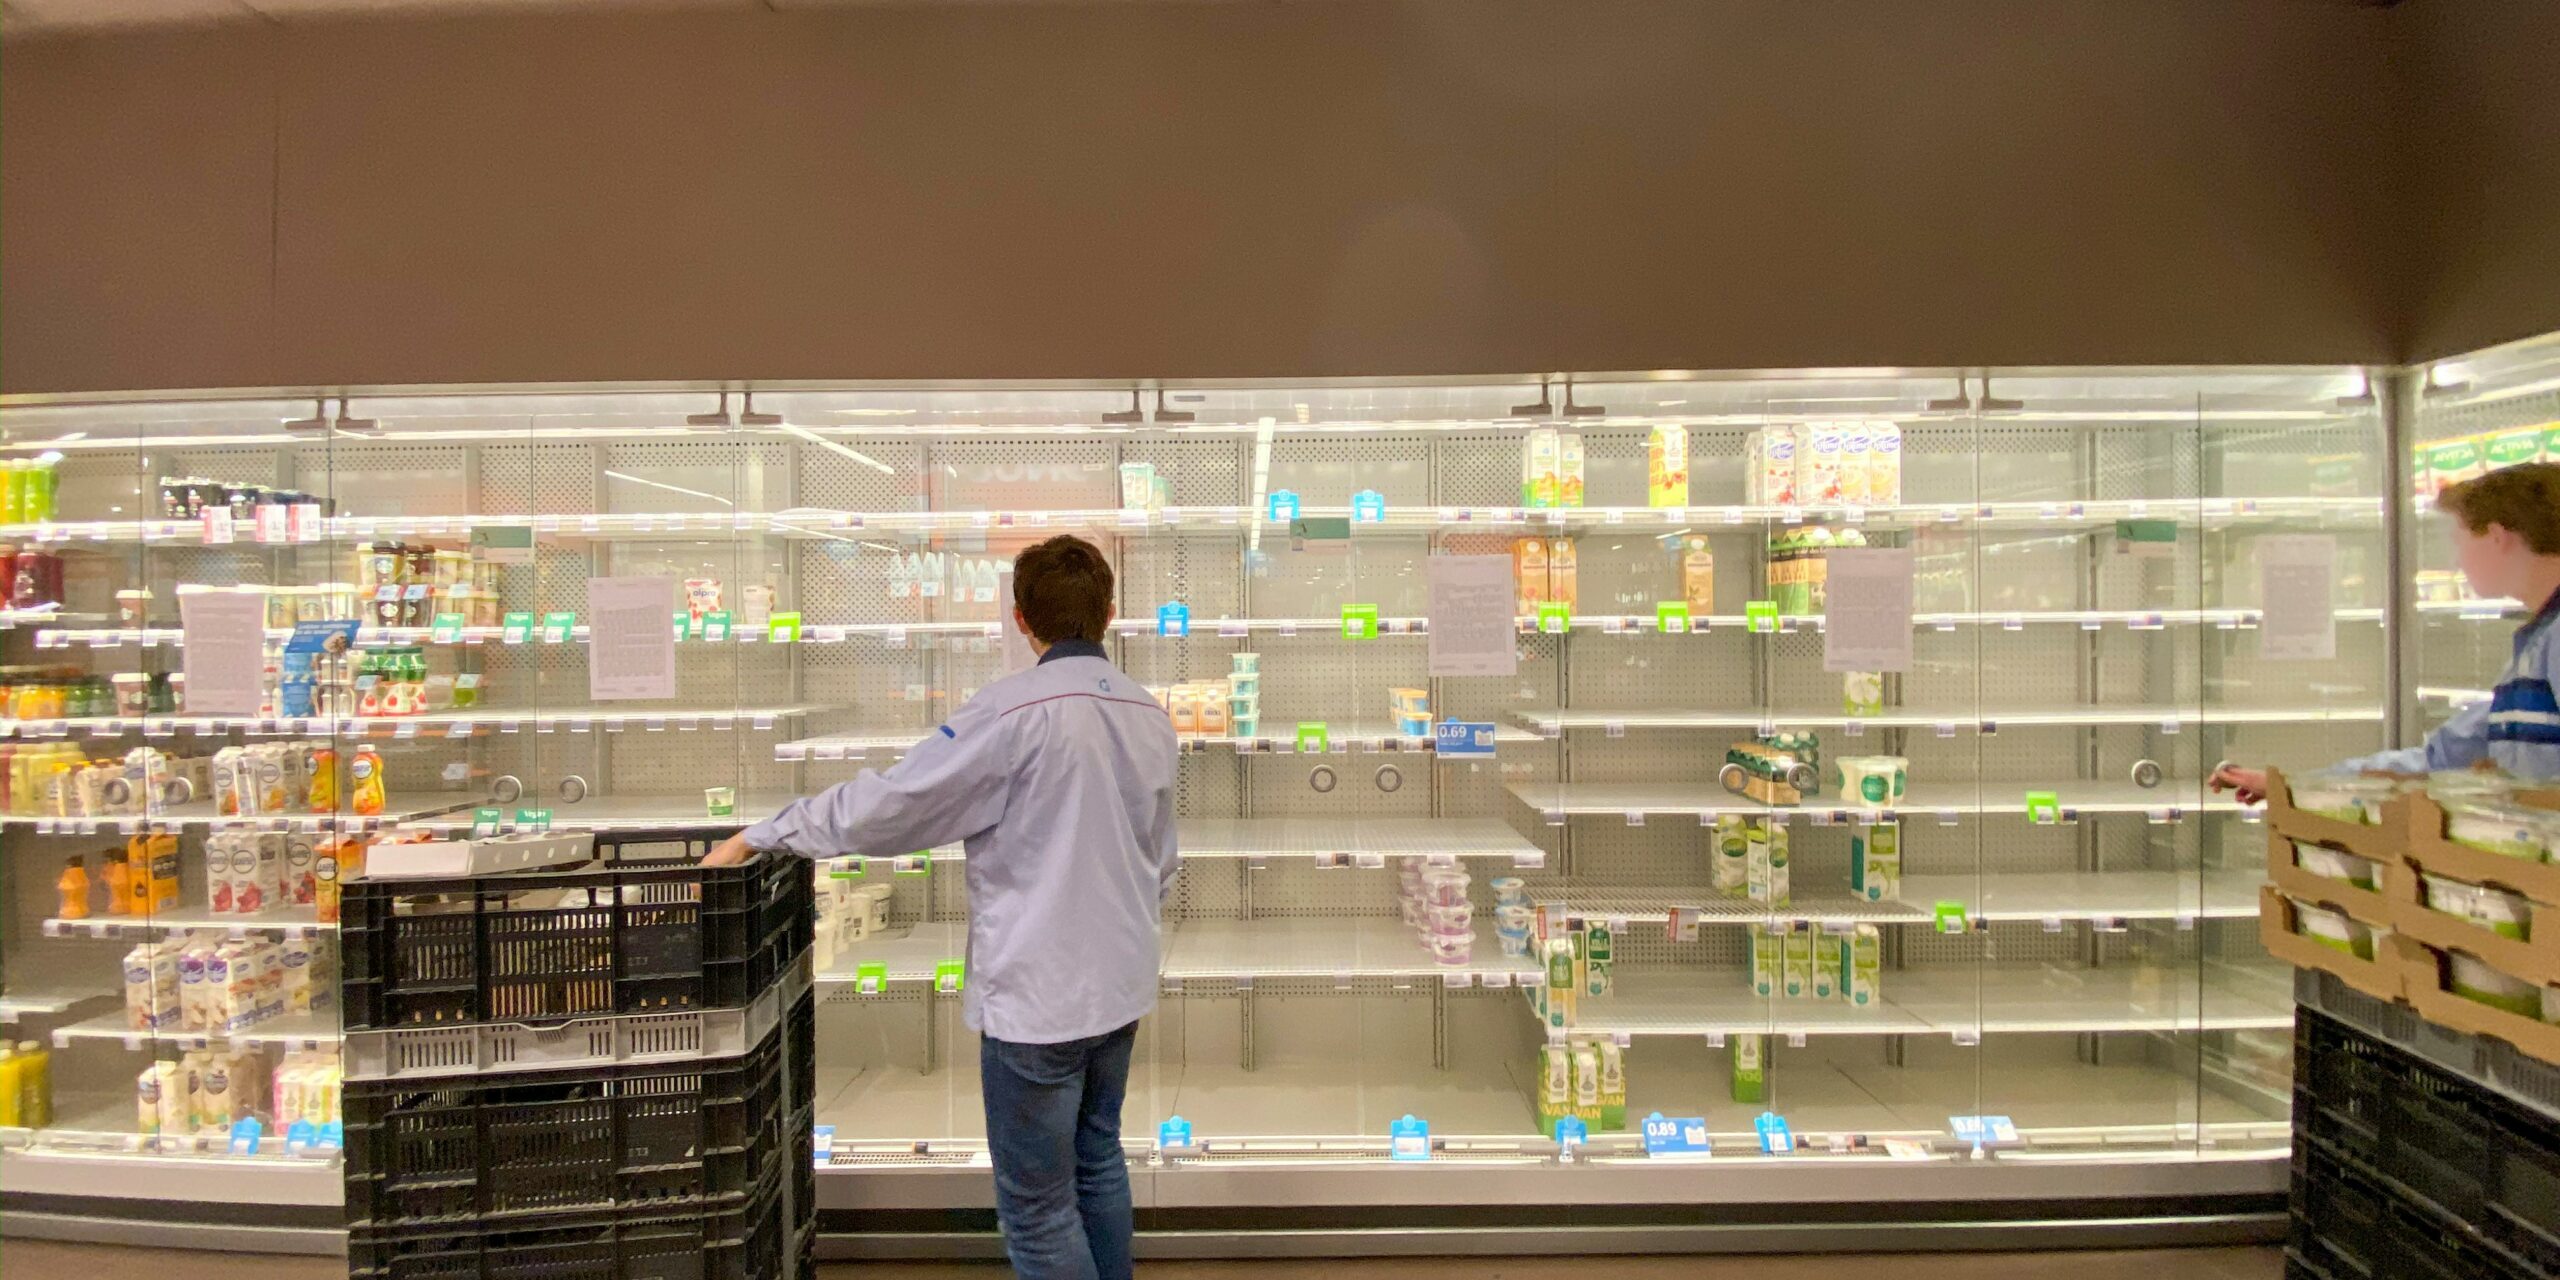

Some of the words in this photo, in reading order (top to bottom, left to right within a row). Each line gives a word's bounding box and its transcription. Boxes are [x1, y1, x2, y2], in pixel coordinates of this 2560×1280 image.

[2490, 438, 2535, 454] ACTIVIA
[692, 589, 716, 598] alpro
[1439, 725, 1467, 738] 0.69
[1574, 1106, 1601, 1119] VAN
[1647, 1121, 1677, 1136] 0.89
